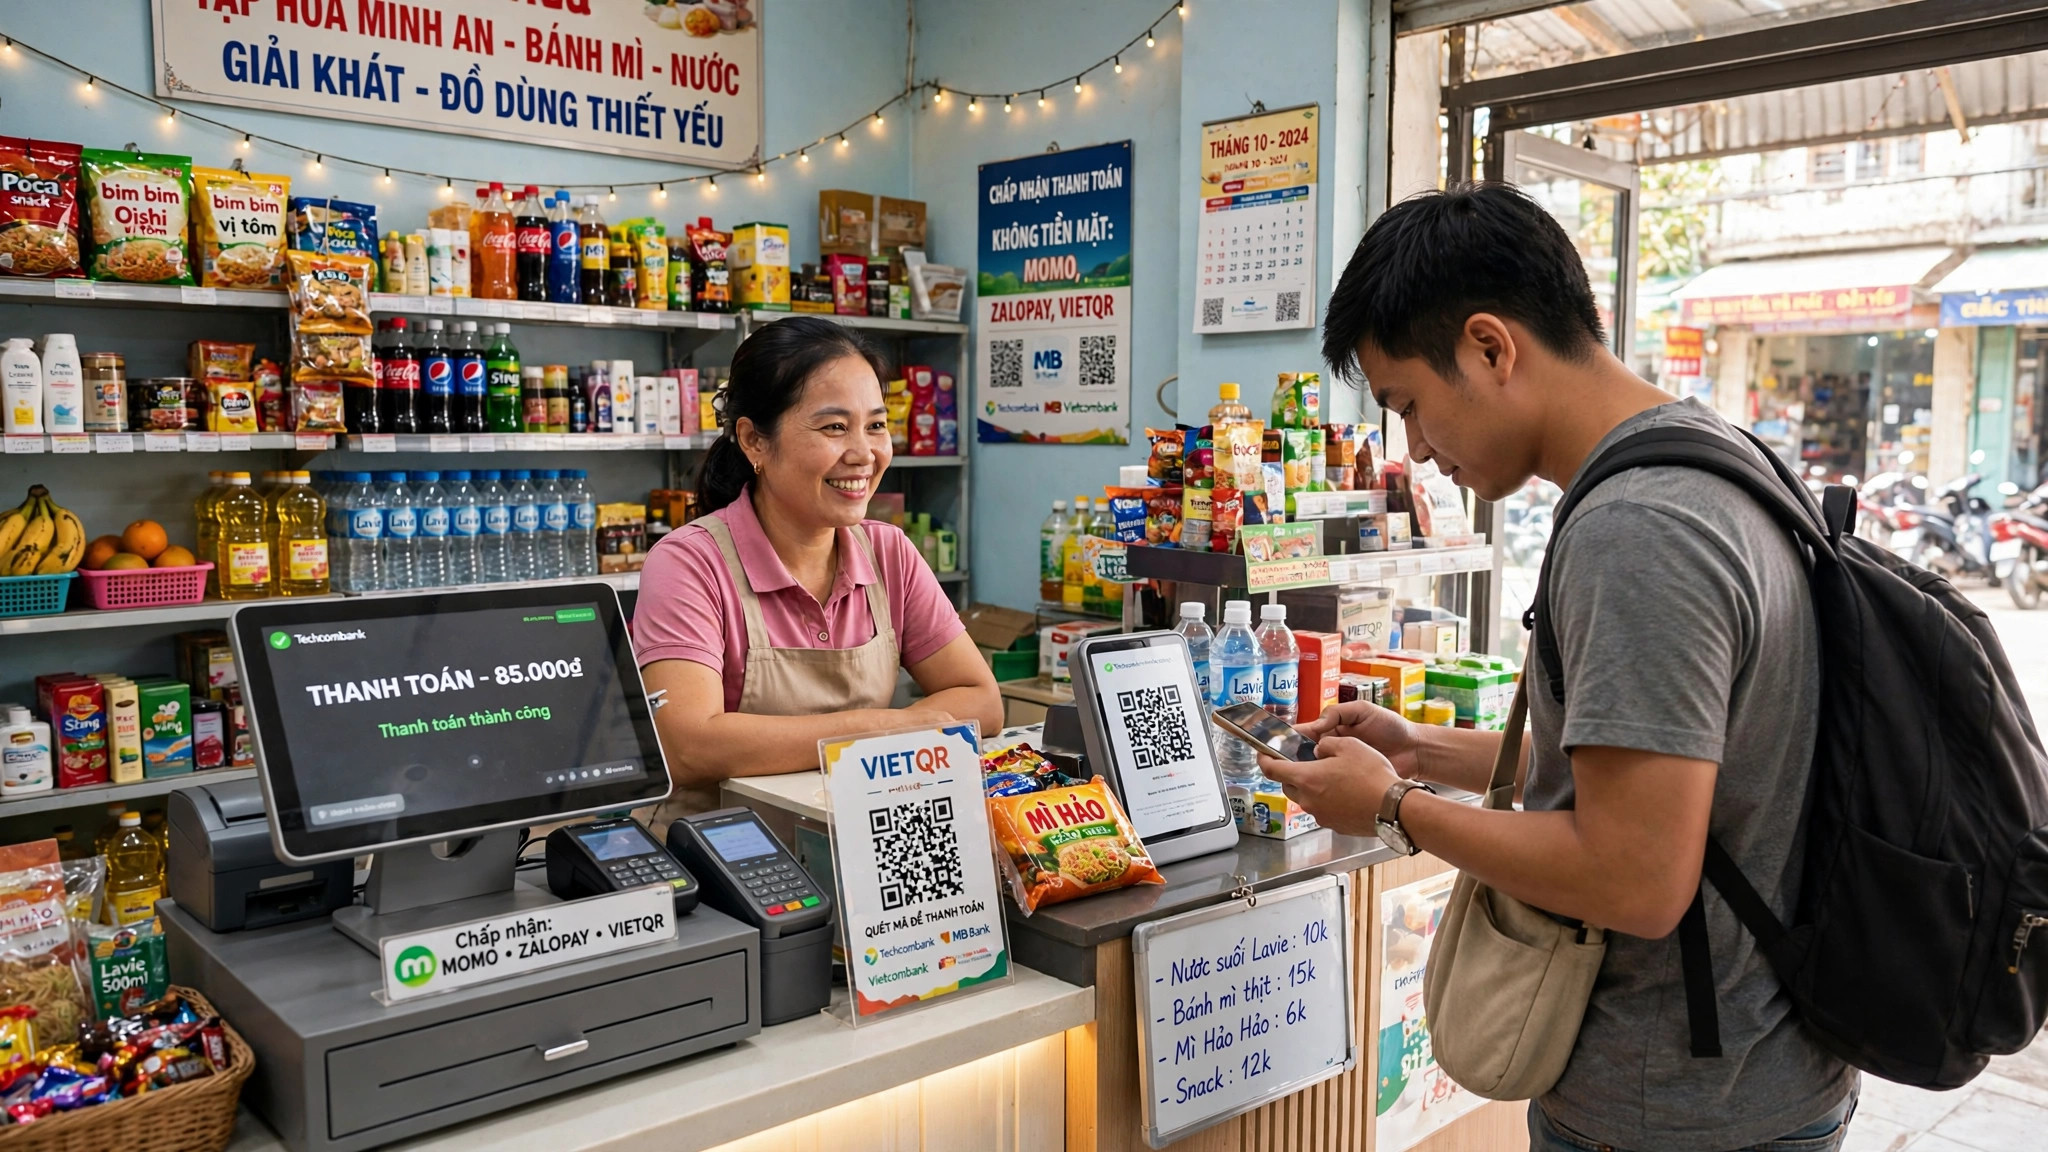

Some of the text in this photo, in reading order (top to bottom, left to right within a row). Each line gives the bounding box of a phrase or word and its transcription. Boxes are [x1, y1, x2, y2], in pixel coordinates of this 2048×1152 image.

[358, 0, 442, 47] MINH
[452, 15, 494, 56] AN
[525, 22, 602, 73] BÁNH
[612, 38, 643, 80] MÌ
[671, 52, 740, 96] NƯỚC
[222, 34, 299, 89] GIẢI
[312, 52, 405, 103] KHÁT
[440, 63, 484, 115] ĐỒ
[495, 76, 578, 128] DÙNG
[587, 91, 666, 139] THIẾT
[673, 100, 723, 149] YẾU
[1209, 134, 1249, 159] THÁNG
[1253, 134, 1267, 151] 10
[1278, 127, 1309, 148] 2024
[1, 172, 60, 196] Poca
[101, 182, 180, 205] bim bim
[989, 163, 1123, 205] CHẤP NHẬN THANH TOÁN
[10, 195, 51, 208] snack
[114, 205, 168, 226] Oishi
[213, 194, 280, 214] bim bim
[219, 217, 277, 238] vị tôm
[992, 211, 1113, 251] KHÔNG TIỀN MẶT:
[1024, 254, 1080, 283] MOMO,
[991, 294, 1114, 323] ZALOPAY, VIETQR
[1034, 350, 1062, 370] MB
[1044, 401, 1062, 414] MB
[306, 677, 401, 706] THANH
[403, 666, 475, 695] TOÁN
[378, 705, 551, 739] Thanh toán thành công
[860, 746, 951, 780] VIETQR
[1025, 801, 1058, 834] MÌ
[1054, 794, 1106, 826] HẢO
[455, 917, 552, 949] Chấp nhận:
[865, 921, 890, 938] QUÉT
[925, 908, 958, 923] THANH
[961, 901, 985, 916] TOÁN
[953, 924, 990, 941] MB Bank
[442, 913, 665, 976] MOMO ZALOPAY VIETQR
[880, 938, 935, 958] Techcombank
[1171, 957, 1210, 986] Nước
[1216, 937, 1246, 972] suối
[1303, 919, 1328, 946] 10k
[101, 957, 146, 978] Lavie
[102, 971, 148, 994] 500ml
[868, 963, 929, 987] Vietcombank
[1173, 991, 1213, 1026] Bánh
[1219, 986, 1236, 1011] mì
[1243, 975, 1271, 1003] thịt
[1289, 958, 1316, 987] 15k
[1175, 1036, 1196, 1065] Mì
[1204, 1024, 1233, 1054] Hảo
[1240, 1012, 1269, 1041] Hảo
[1286, 998, 1306, 1026] 6k
[1176, 1065, 1224, 1104] Snack
[1241, 1049, 1271, 1079] 12k
